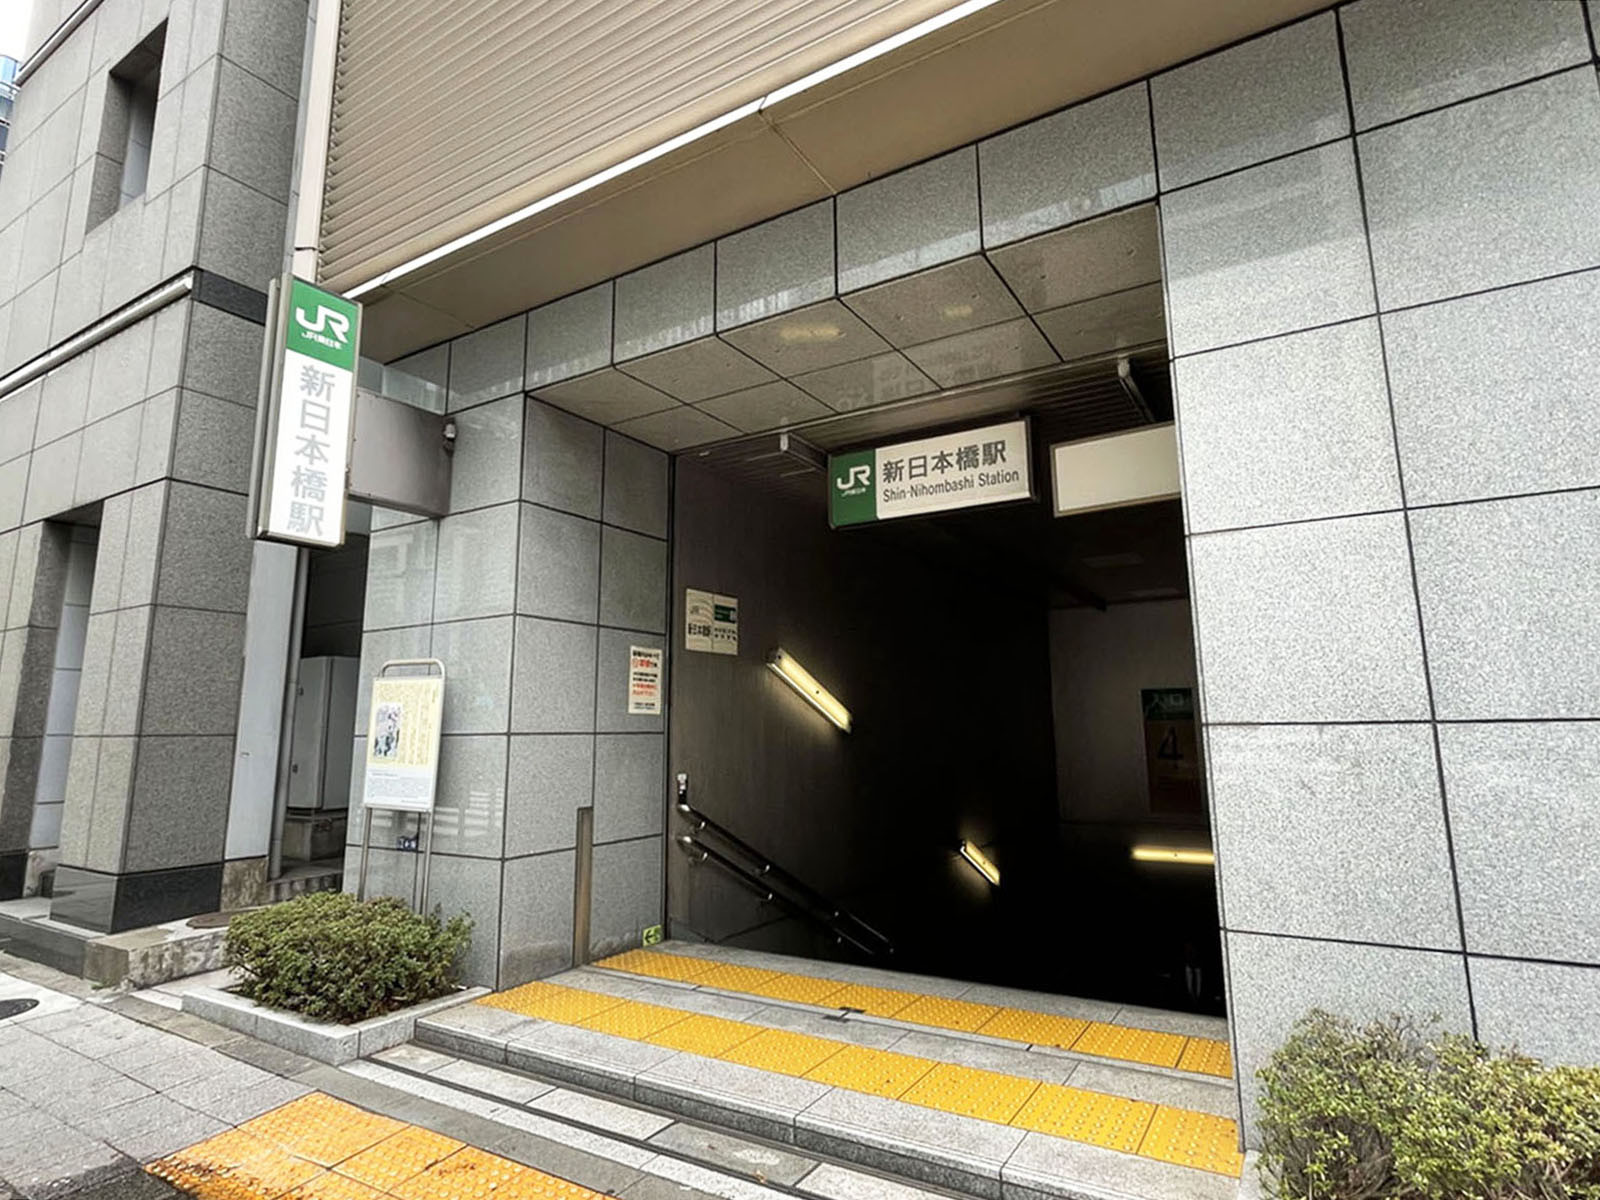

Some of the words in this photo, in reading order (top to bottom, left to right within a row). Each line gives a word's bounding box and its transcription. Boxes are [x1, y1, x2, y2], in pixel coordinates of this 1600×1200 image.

[296, 304, 350, 344] JR
[286, 364, 336, 537] 新日本橋駅
[882, 439, 1007, 483] 新日本橋駅
[836, 464, 871, 490] JR
[882, 476, 975, 503] Shin-Nihombashi
[978, 468, 1020, 488] Station
